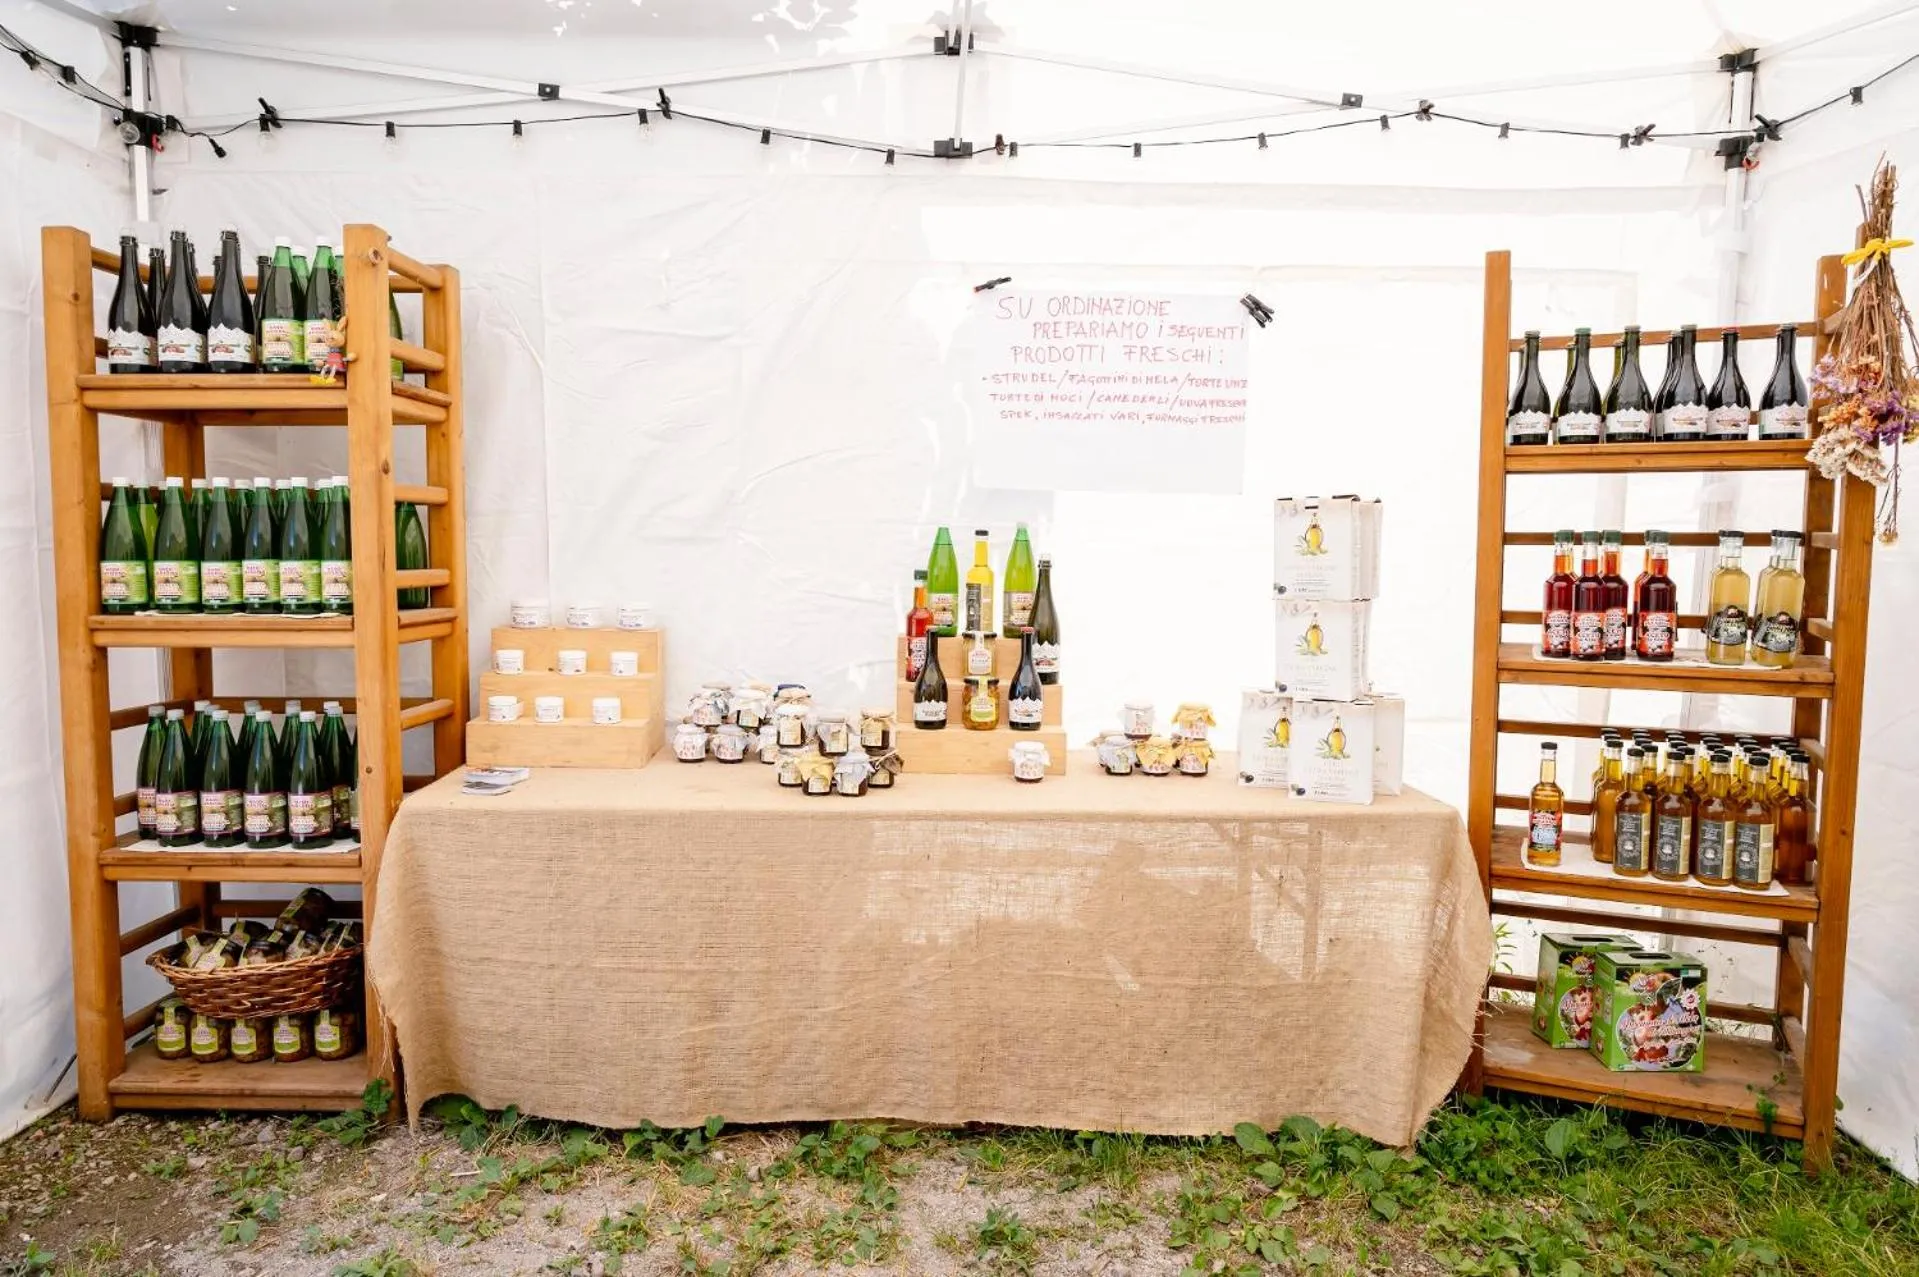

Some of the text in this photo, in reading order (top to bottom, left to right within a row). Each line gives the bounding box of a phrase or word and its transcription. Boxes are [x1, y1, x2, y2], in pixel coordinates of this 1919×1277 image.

[996, 295, 1171, 320] SU ORDINAZIONE
[1032, 320, 1149, 340] PREPARIAMO
[1010, 343, 1105, 364] PRODOTTI
